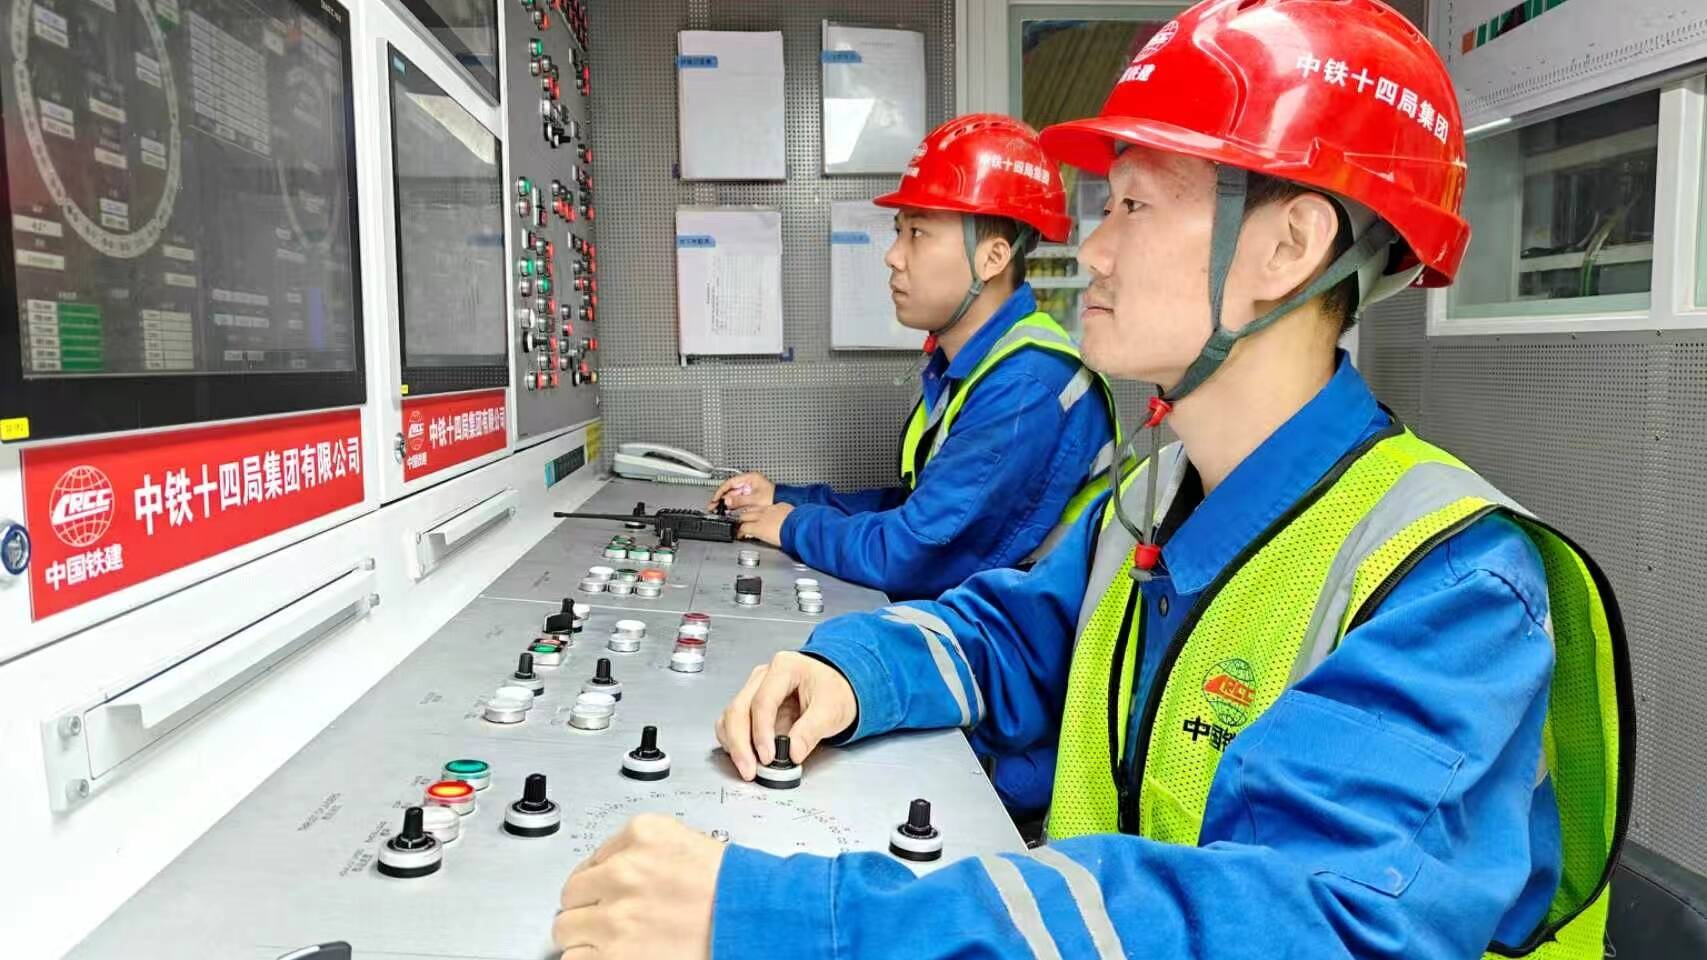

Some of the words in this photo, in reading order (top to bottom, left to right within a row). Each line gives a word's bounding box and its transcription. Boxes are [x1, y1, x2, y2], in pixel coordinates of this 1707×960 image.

[1295, 51, 1449, 145] 中铁十四局集团
[428, 406, 505, 449] 中铁十四局集团有限公司
[134, 436, 361, 536] 中铁十四局集团有限公司
[45, 543, 124, 592] 中国铁建
